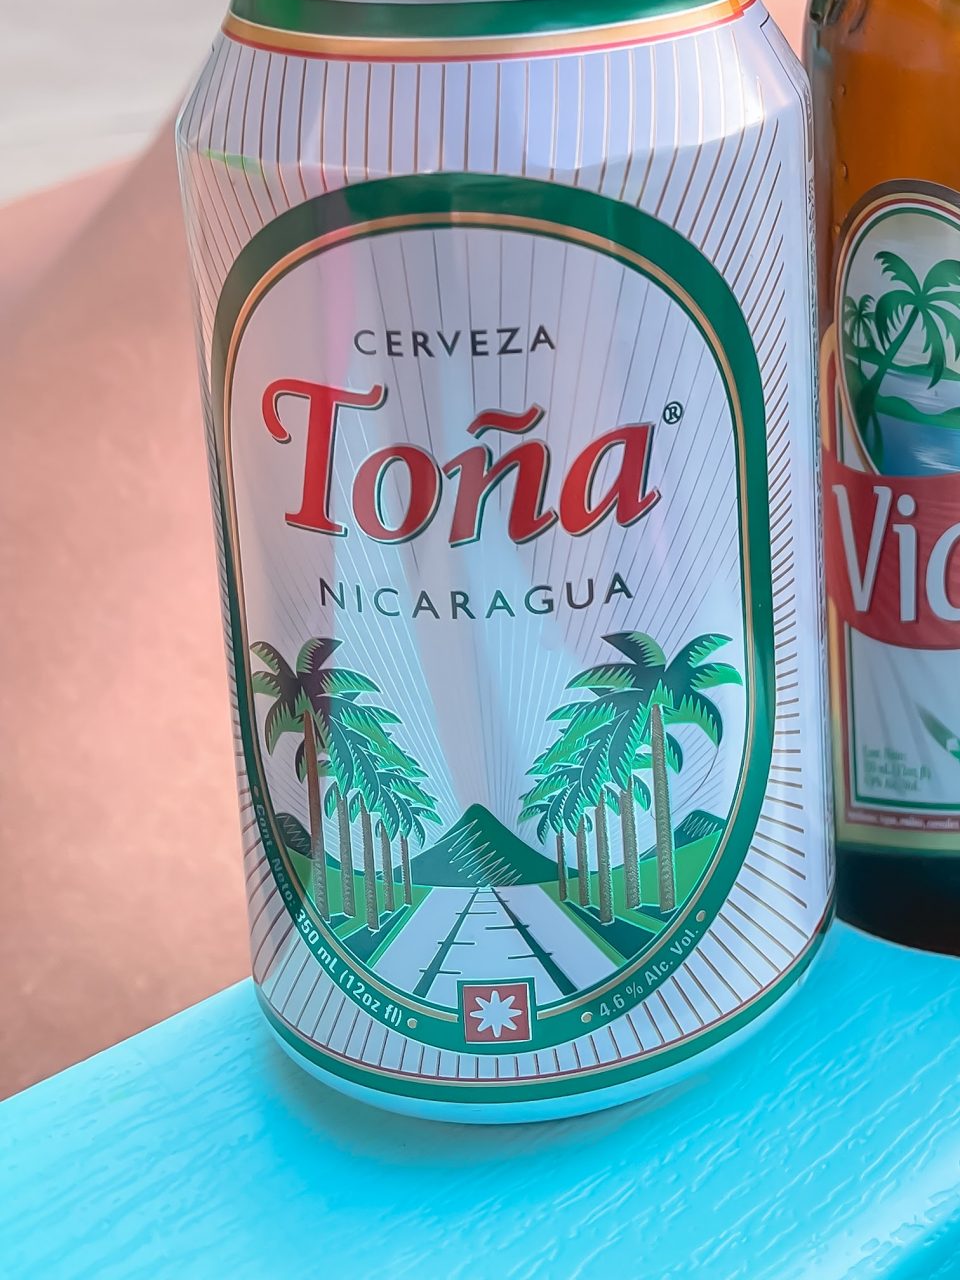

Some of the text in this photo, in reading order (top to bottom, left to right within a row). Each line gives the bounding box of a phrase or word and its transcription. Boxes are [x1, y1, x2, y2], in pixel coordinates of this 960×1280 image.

[353, 324, 556, 359] CERVEZA
[262, 377, 662, 549] Toña
[319, 572, 634, 620] NICARAGUA
[272, 857, 297, 907] Neto:
[294, 908, 320, 945] 350
[317, 946, 338, 974] mL
[339, 969, 381, 1013] (12oz
[384, 1004, 402, 1027] fl)
[599, 928, 699, 1017] 4.6 % Alc. Vol.
